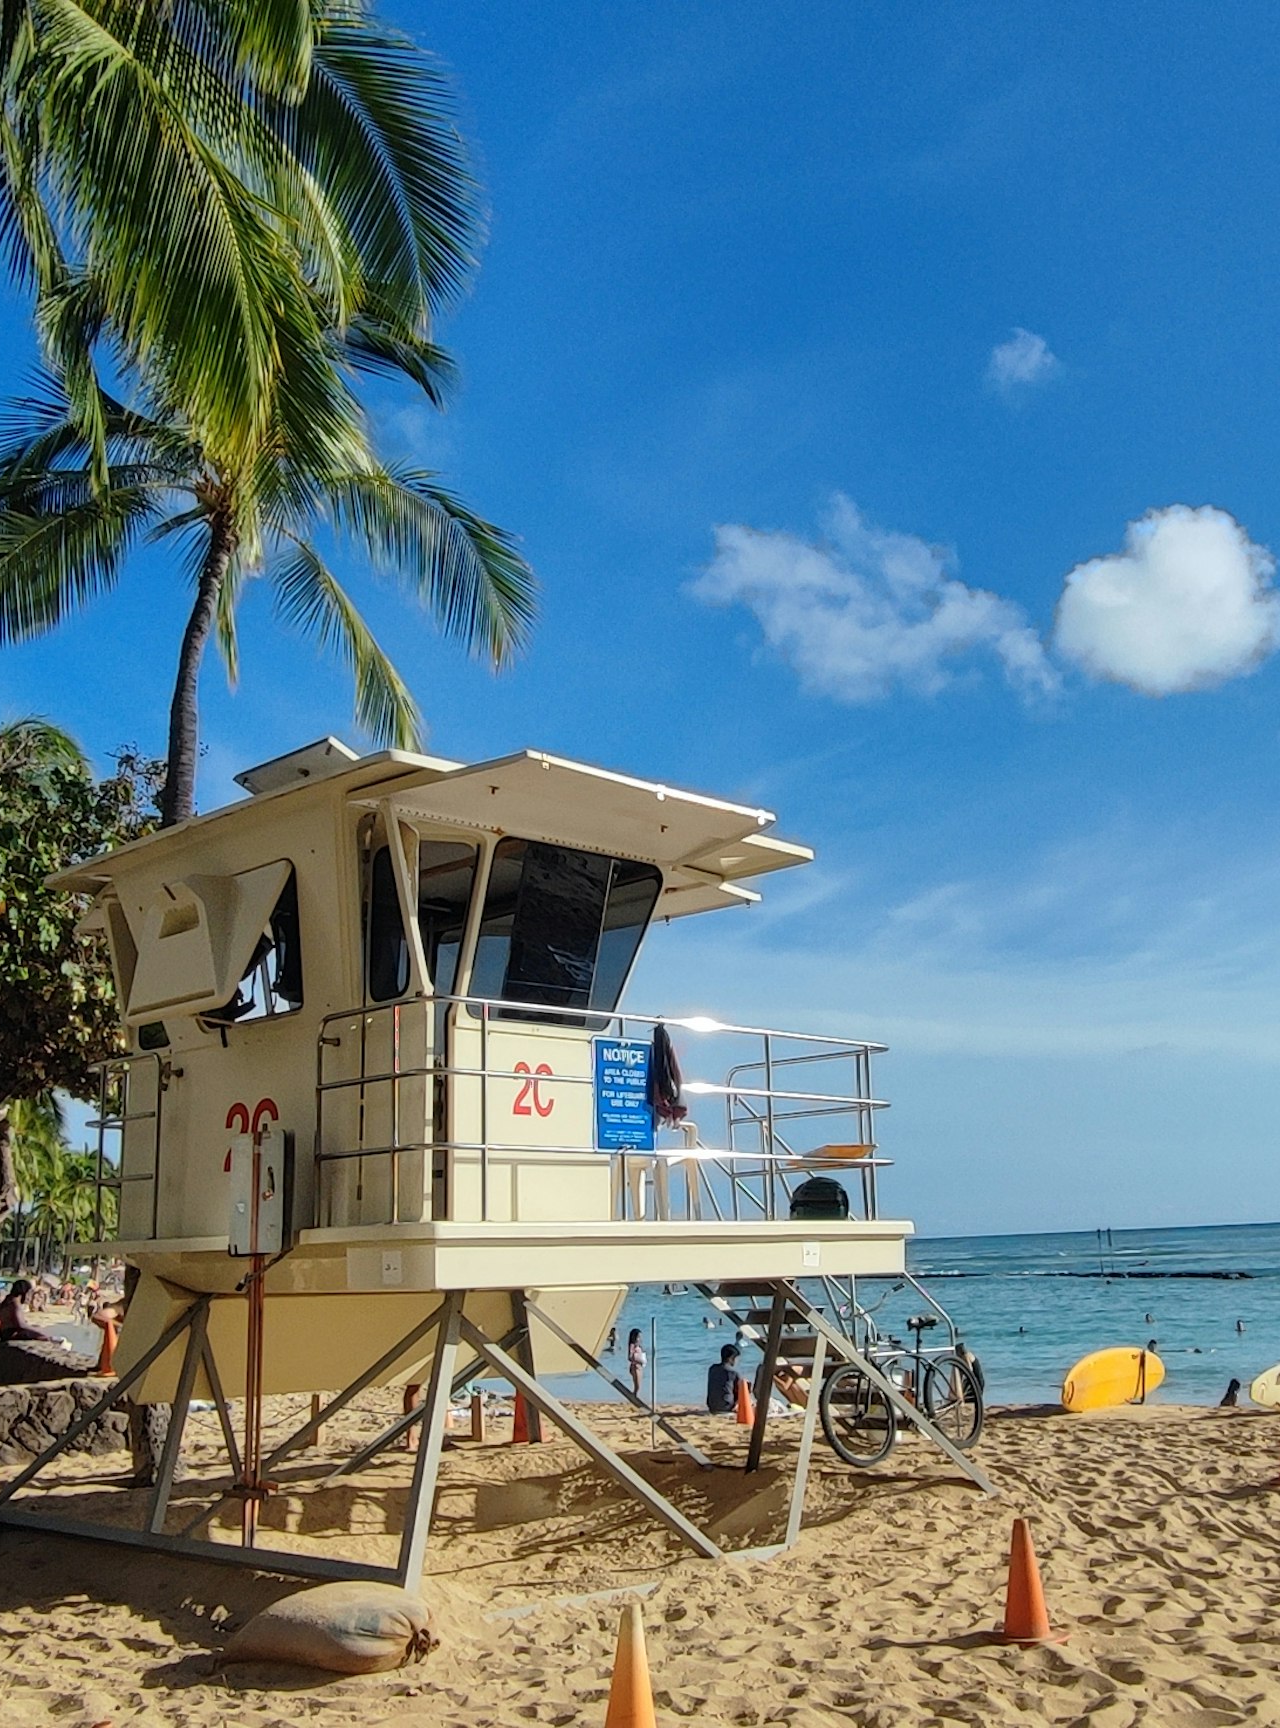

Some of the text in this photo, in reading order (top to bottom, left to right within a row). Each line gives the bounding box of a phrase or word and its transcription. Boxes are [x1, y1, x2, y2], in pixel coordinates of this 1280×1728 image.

[603, 1048, 645, 1064] NOTICE
[604, 1068, 645, 1078] AREA CLOSED
[603, 1075, 647, 1086] TO THE PUBLIC
[513, 1061, 555, 1118] 2C
[602, 1090, 615, 1098] FOR
[611, 1098, 640, 1108] USE ONLY
